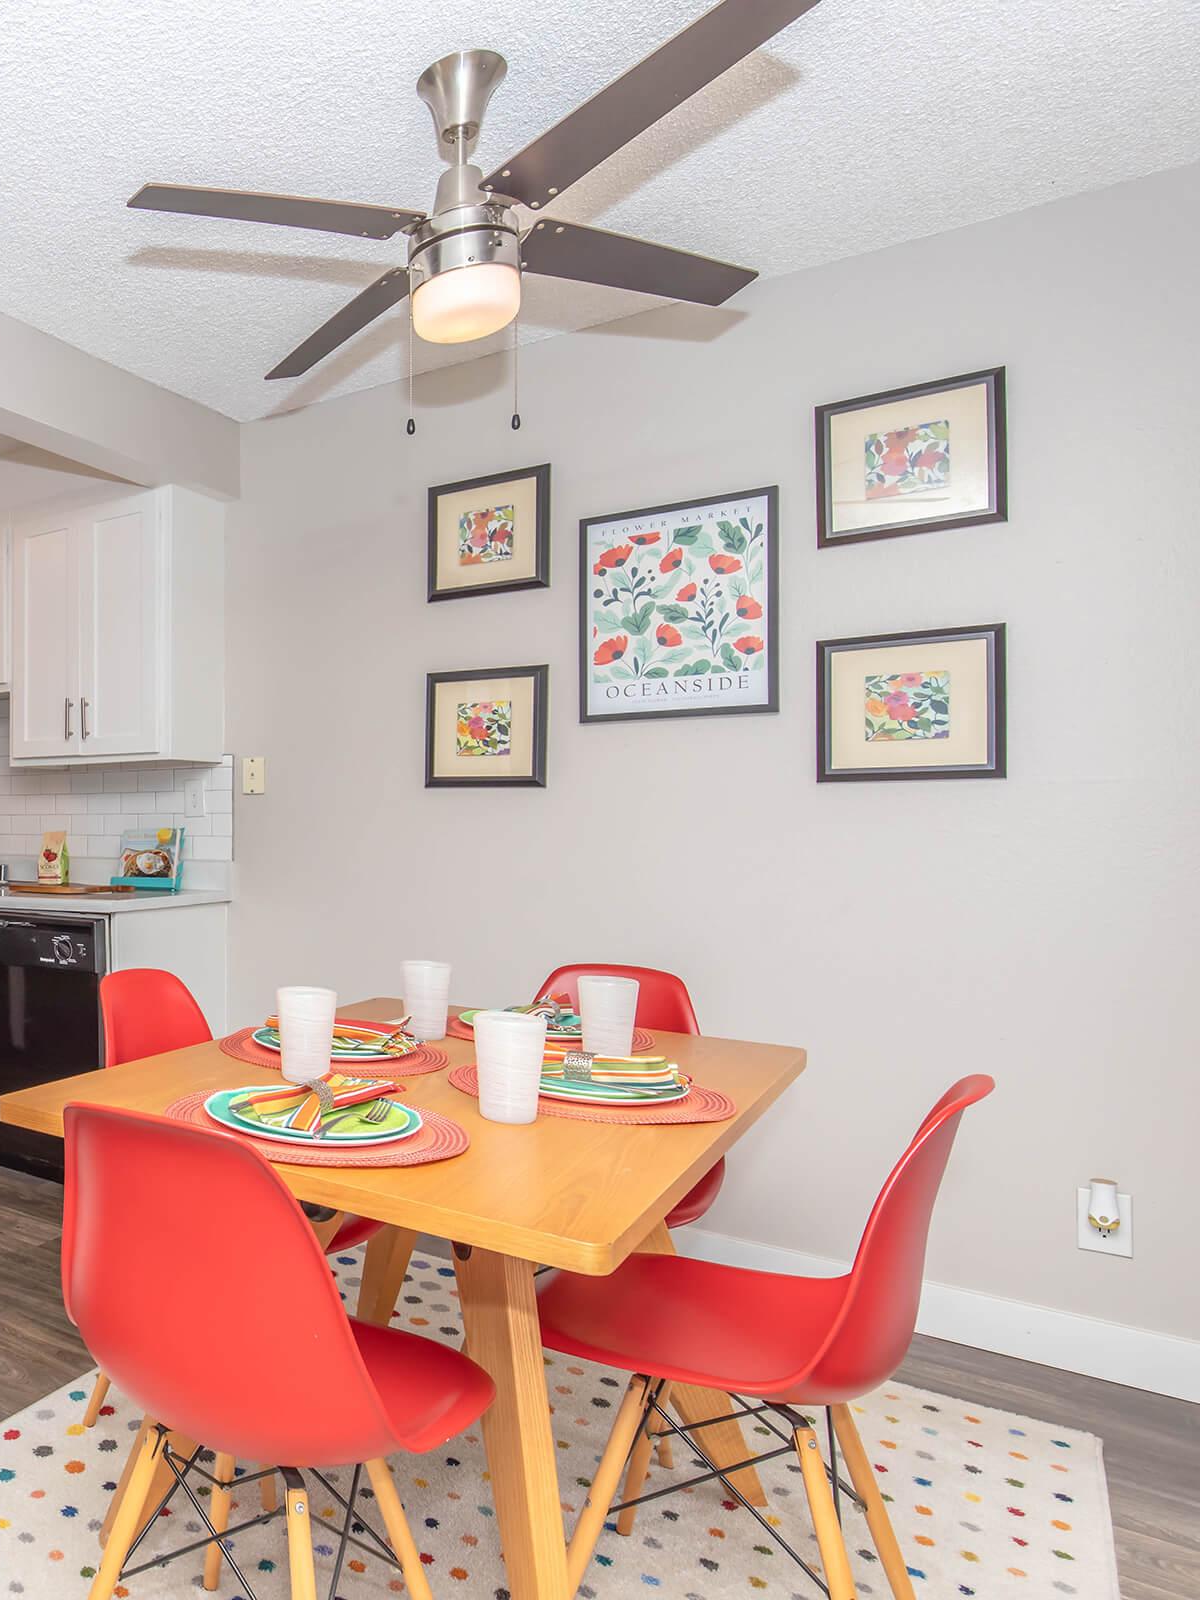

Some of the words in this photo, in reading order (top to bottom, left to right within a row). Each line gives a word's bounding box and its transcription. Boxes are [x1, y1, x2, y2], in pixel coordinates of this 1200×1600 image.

[601, 520, 667, 537] FLOWER
[681, 505, 752, 523] MARKET
[606, 675, 749, 699] OCEANSIDE
